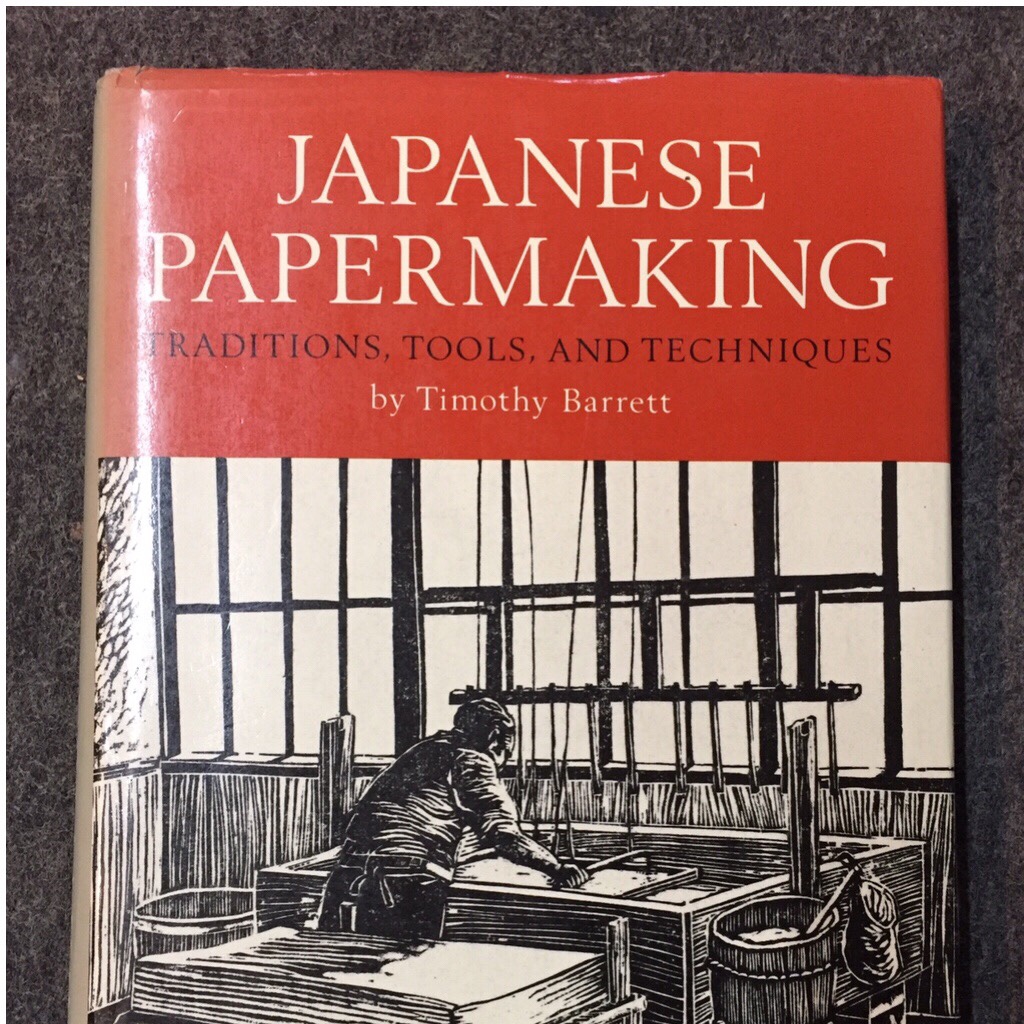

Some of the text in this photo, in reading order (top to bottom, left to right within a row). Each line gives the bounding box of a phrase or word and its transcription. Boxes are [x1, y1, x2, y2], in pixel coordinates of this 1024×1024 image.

[276, 132, 766, 211] JAPANESE
[147, 230, 894, 311] PAPERMAKING
[144, 331, 893, 370] TRADITIONS, TOOLS, AND TECHNIQUES
[371, 383, 672, 420] by Timothy Barrett
